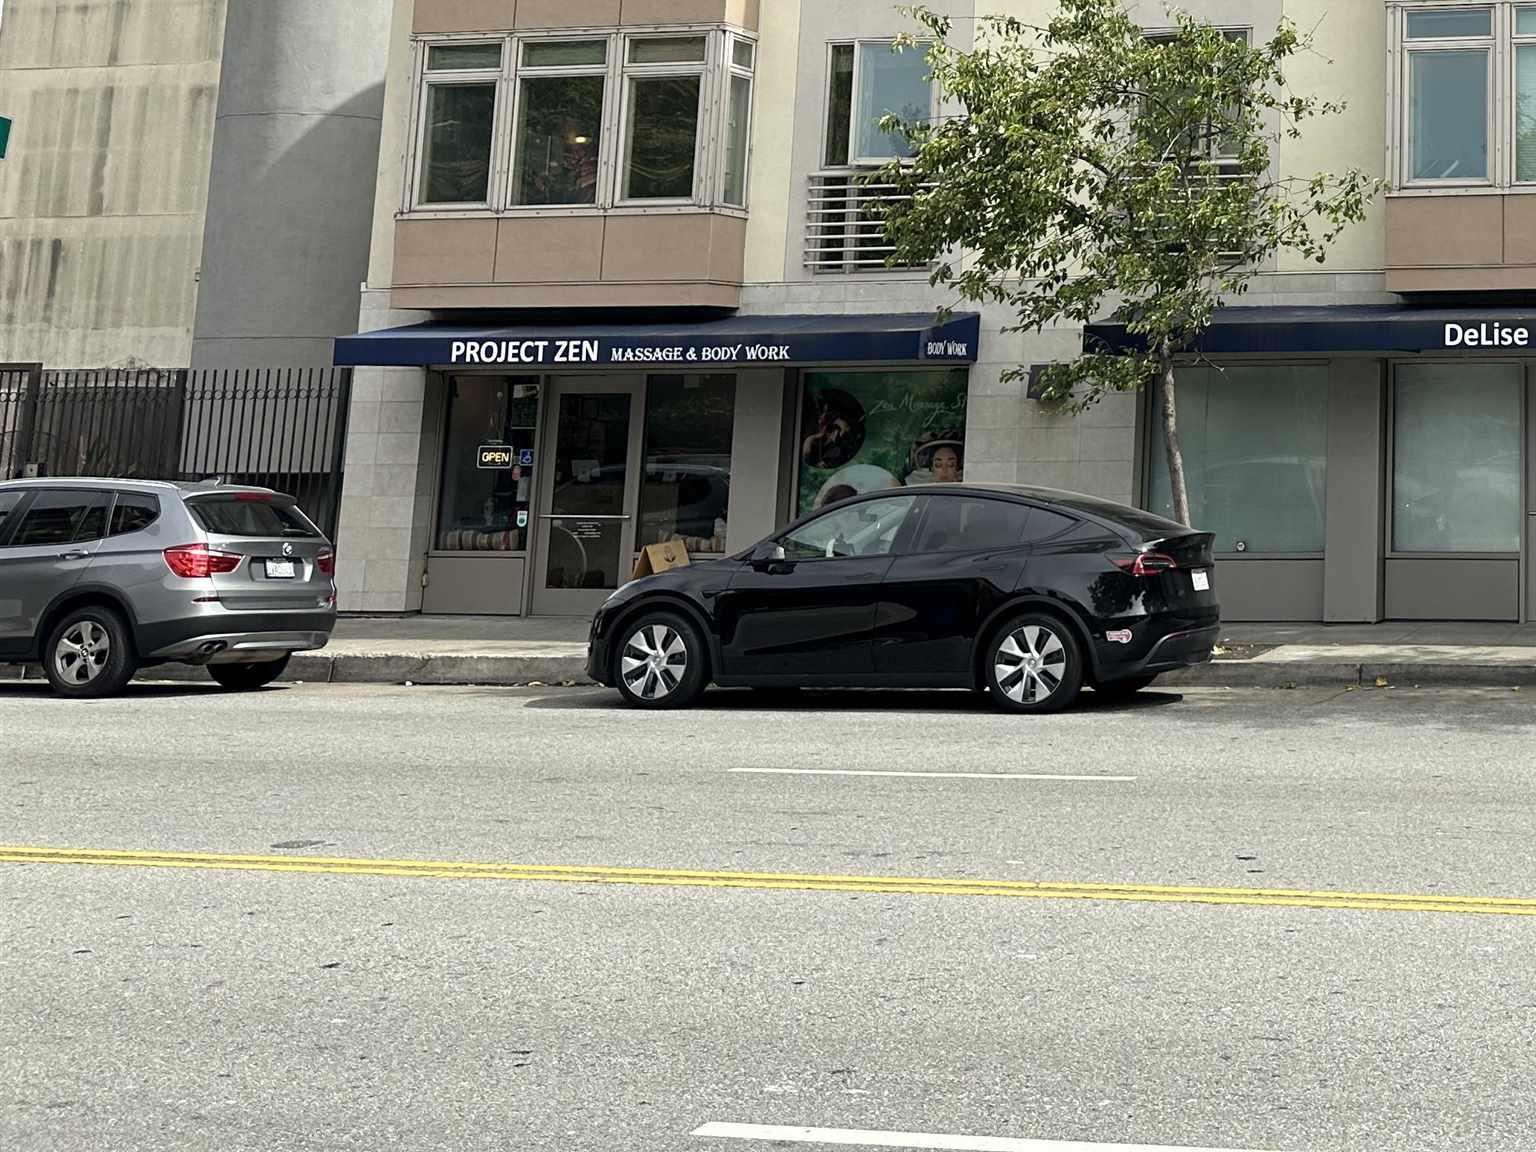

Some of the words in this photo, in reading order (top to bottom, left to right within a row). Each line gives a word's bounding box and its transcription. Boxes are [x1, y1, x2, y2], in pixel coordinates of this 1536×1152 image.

[1444, 322, 1529, 346] DeLise
[451, 341, 548, 362] PROJECT
[554, 340, 599, 362] ZEN
[611, 347, 683, 361] MASSAGE
[686, 347, 697, 361] &
[701, 344, 742, 361] BODY
[745, 344, 790, 360] WORK
[927, 340, 947, 355] BODY
[947, 340, 968, 356] WORK
[481, 452, 510, 462] OPEN
